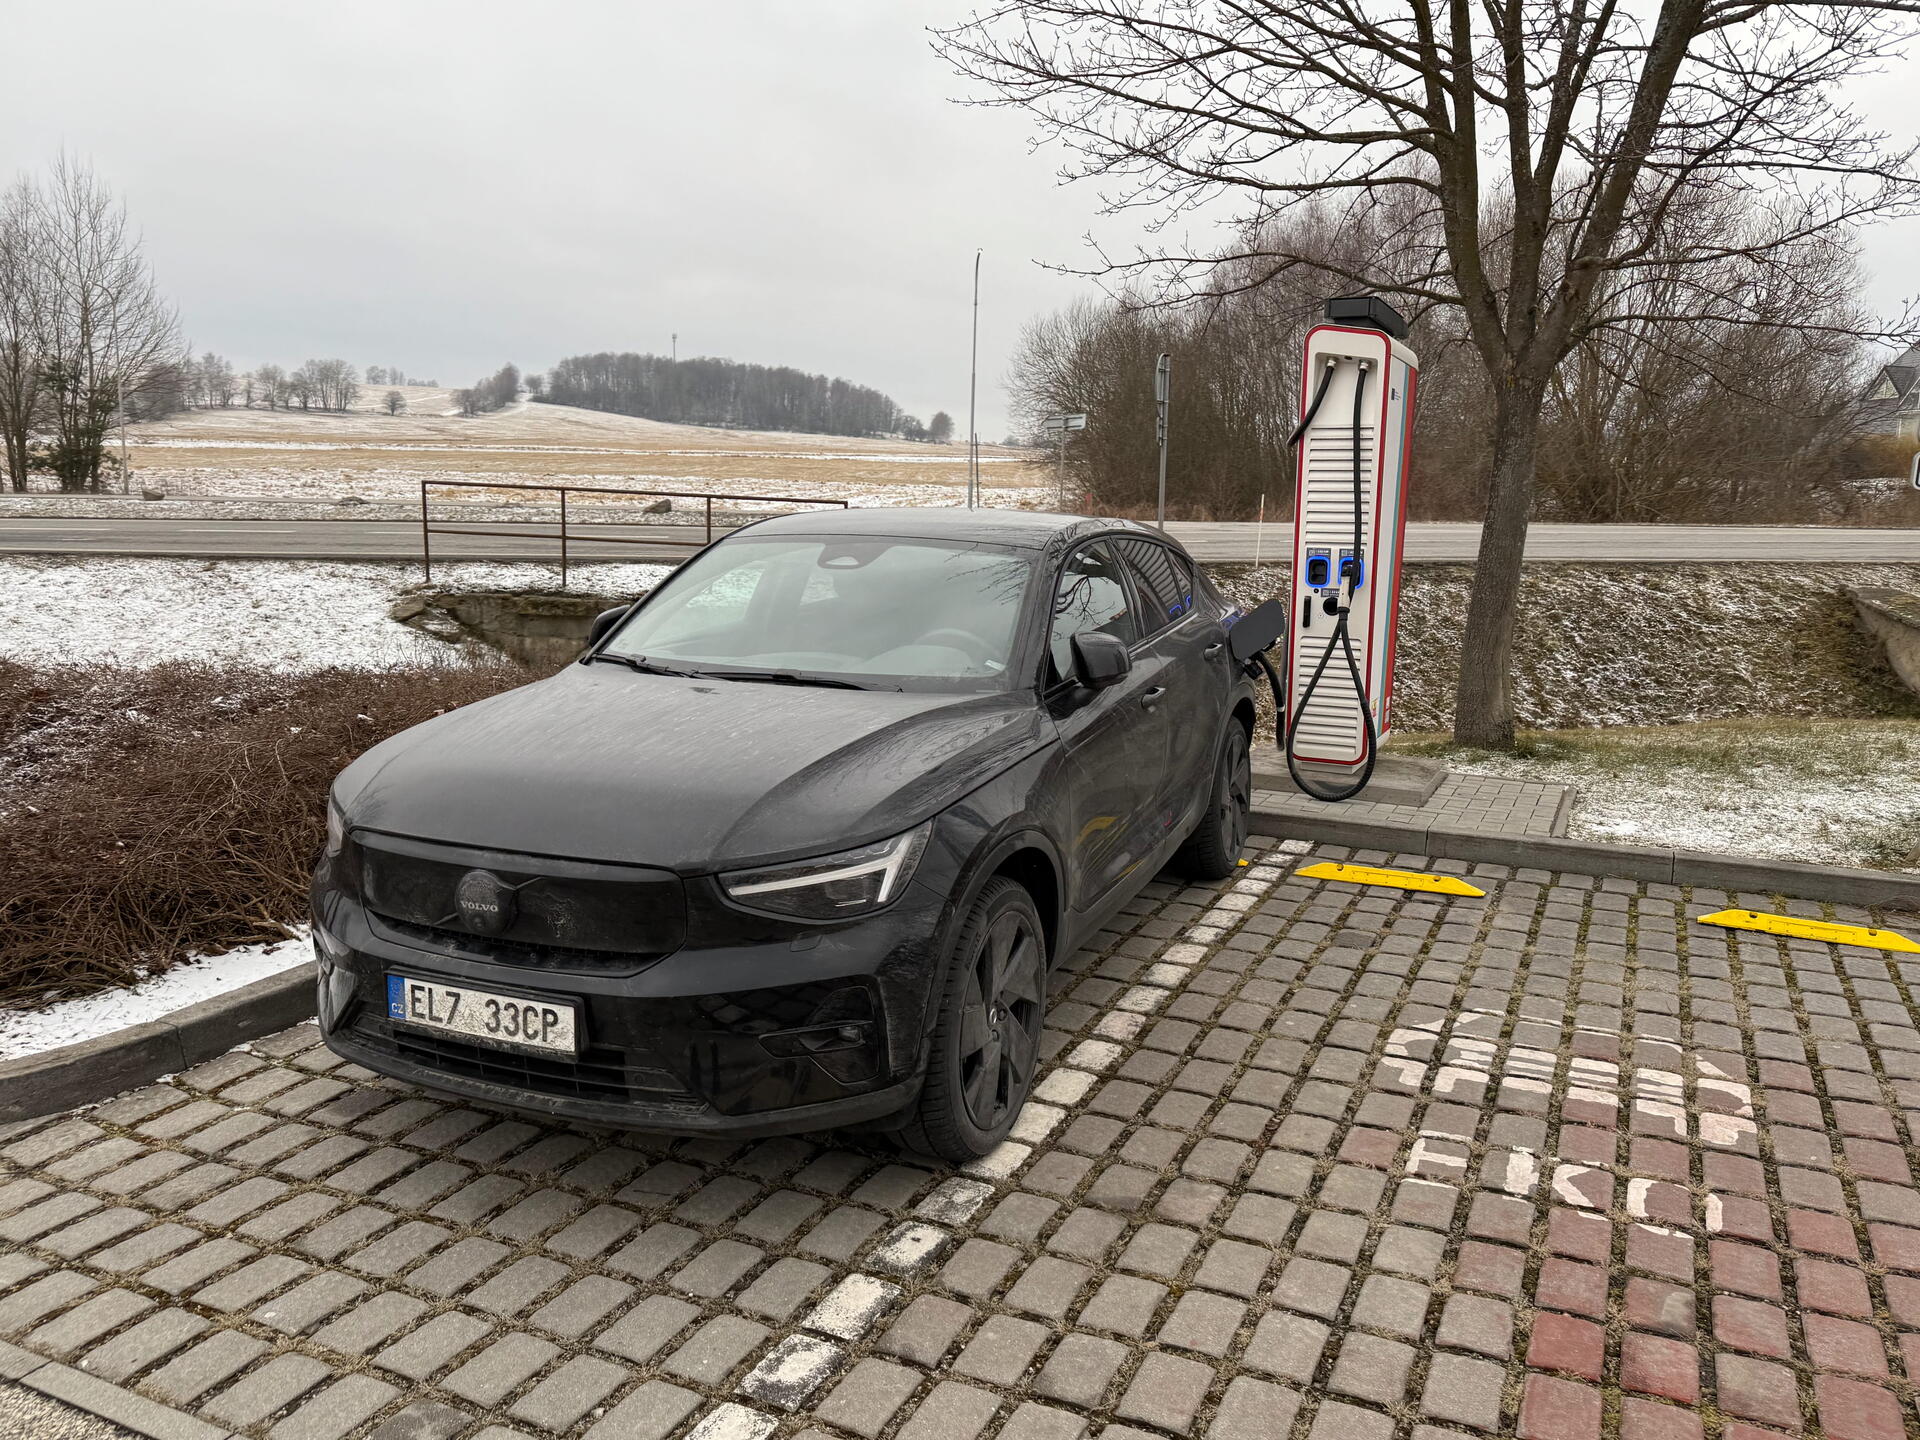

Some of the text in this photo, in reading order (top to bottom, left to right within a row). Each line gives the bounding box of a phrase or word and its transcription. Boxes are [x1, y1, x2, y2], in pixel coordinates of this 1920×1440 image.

[460, 901, 498, 912] VOLVO
[391, 1002, 404, 1014] CZ
[410, 984, 559, 1043] EL7 33CP
